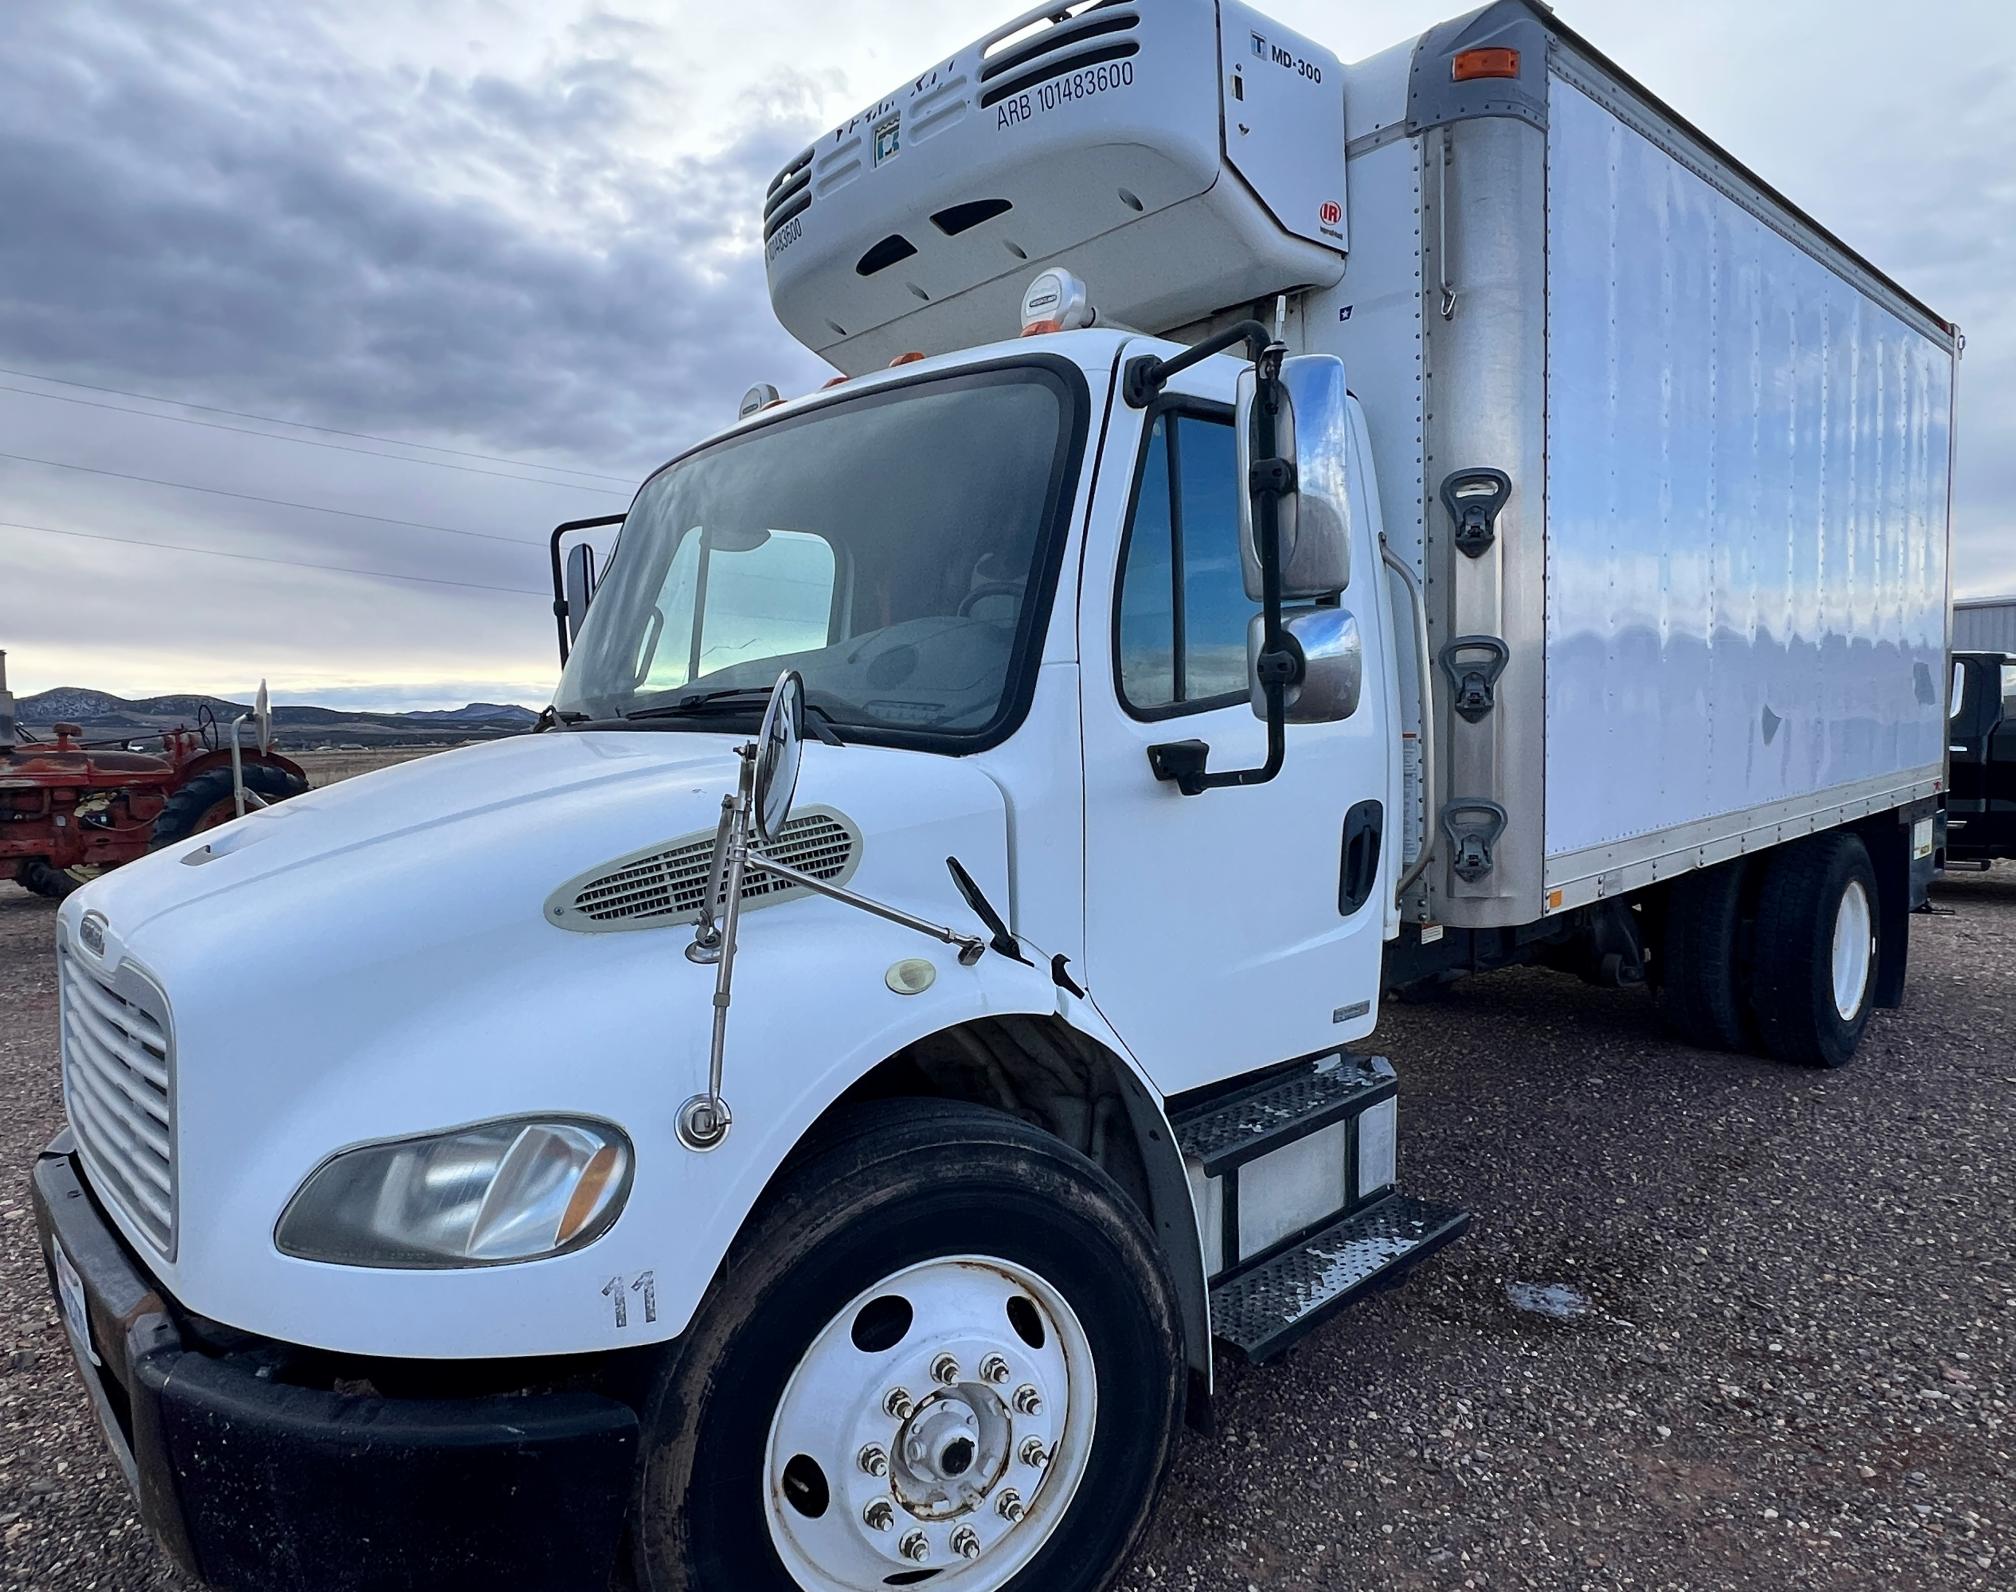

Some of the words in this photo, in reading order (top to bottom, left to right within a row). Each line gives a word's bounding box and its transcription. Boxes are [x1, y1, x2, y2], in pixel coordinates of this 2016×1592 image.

[1271, 44, 1321, 84] MD-300
[997, 94, 1032, 131] ARB
[1037, 61, 1133, 113] 101483600
[1322, 202, 1339, 224] IR
[601, 1270, 657, 1328] 11
